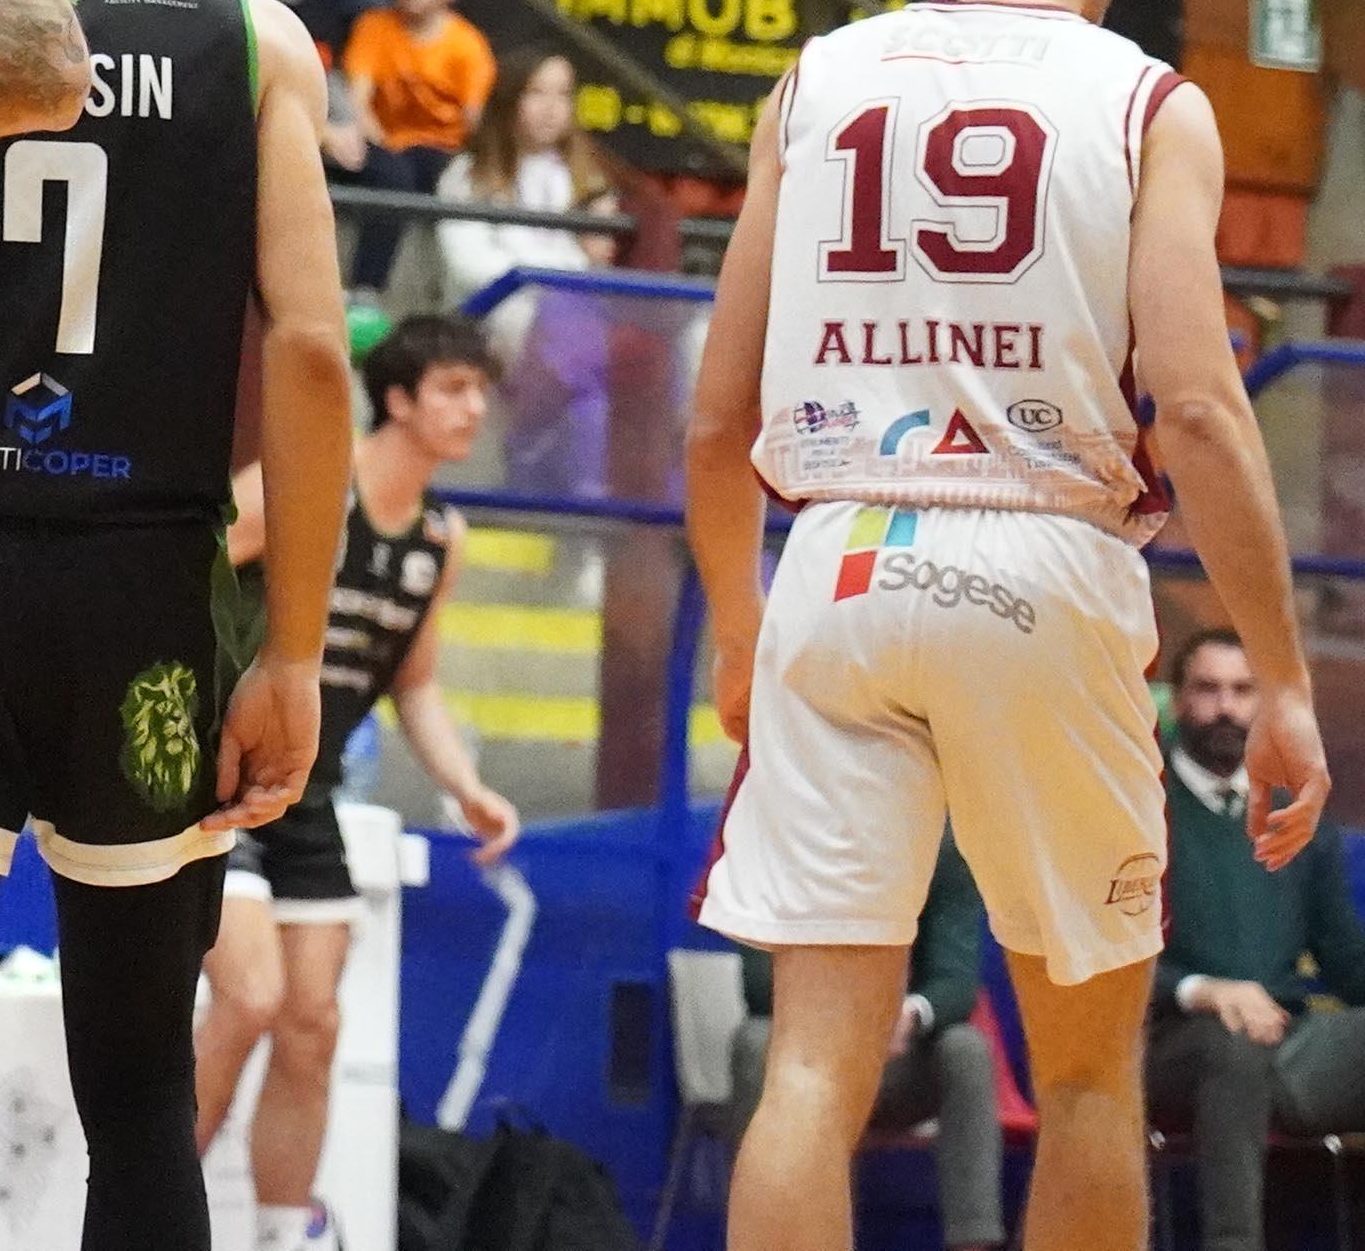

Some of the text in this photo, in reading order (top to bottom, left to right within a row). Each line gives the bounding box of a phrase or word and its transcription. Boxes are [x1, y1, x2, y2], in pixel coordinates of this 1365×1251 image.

[84, 54, 173, 120] SIN
[817, 96, 1059, 284] 19
[3, 140, 109, 355] 7
[813, 318, 1046, 371] ALLINEI
[877, 551, 1037, 636] Sogese
